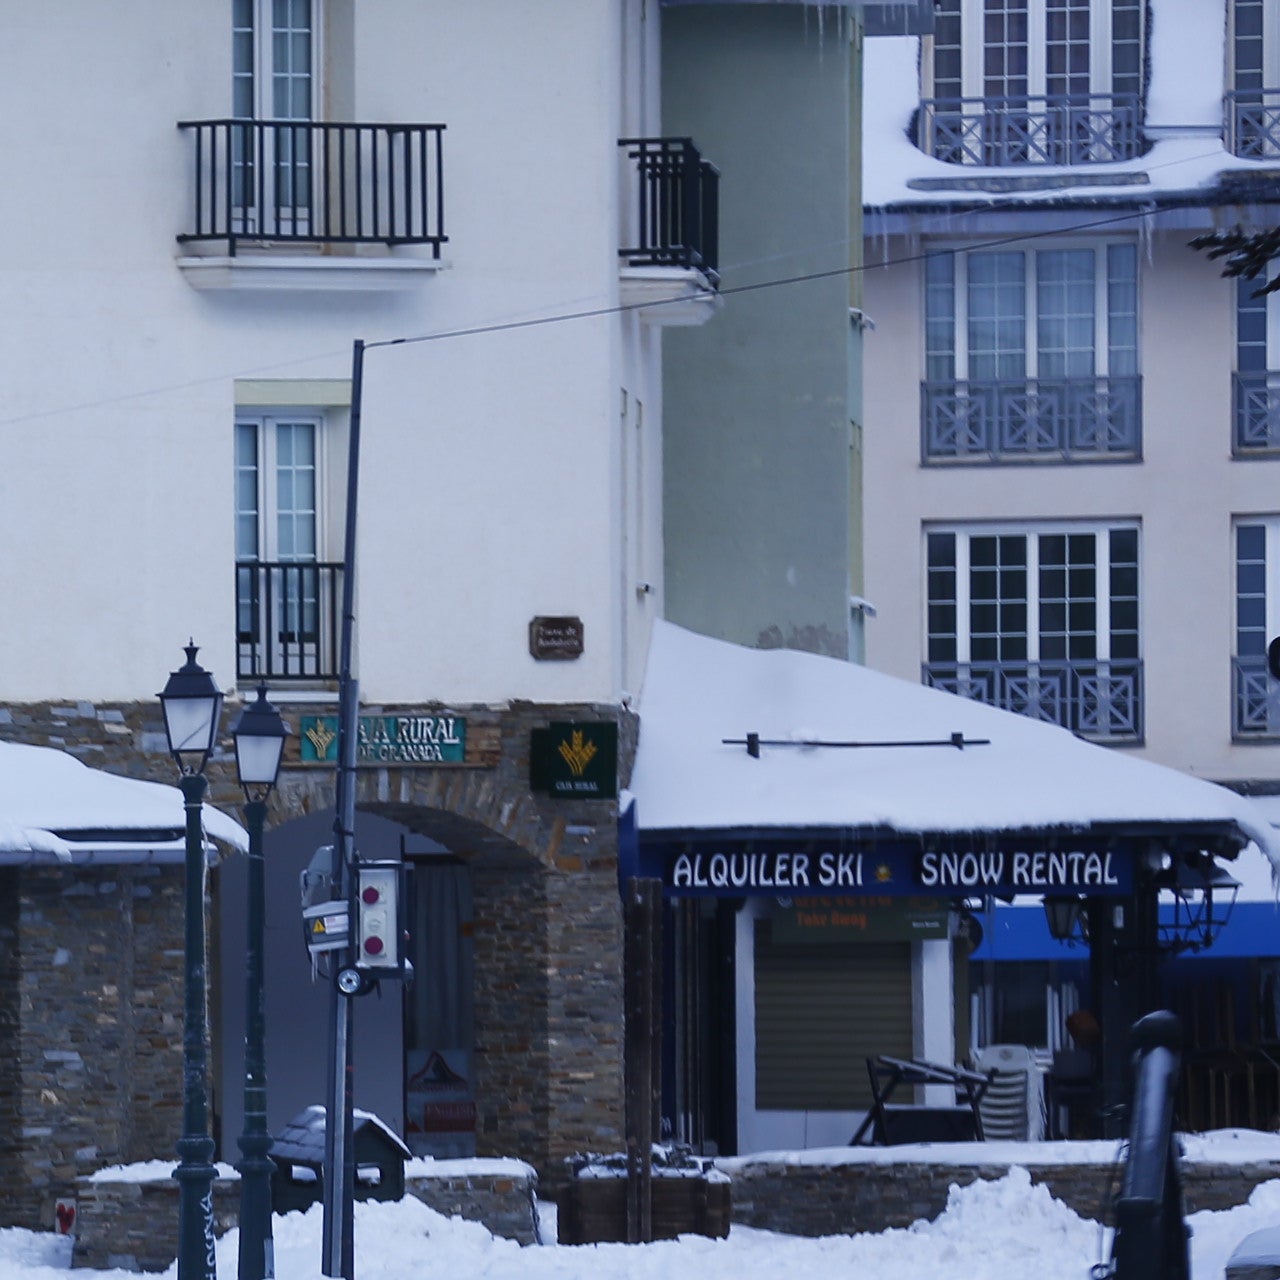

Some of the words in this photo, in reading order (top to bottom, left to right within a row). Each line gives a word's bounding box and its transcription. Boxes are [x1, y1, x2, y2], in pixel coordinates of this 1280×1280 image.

[396, 717, 460, 744] RURAL
[379, 744, 444, 762] GRANADA
[673, 853, 810, 887] ALQUILER
[818, 853, 863, 886] SKI
[921, 853, 1004, 886] SNOW
[1012, 853, 1118, 886] RENTAL
[796, 911, 827, 927] Take
